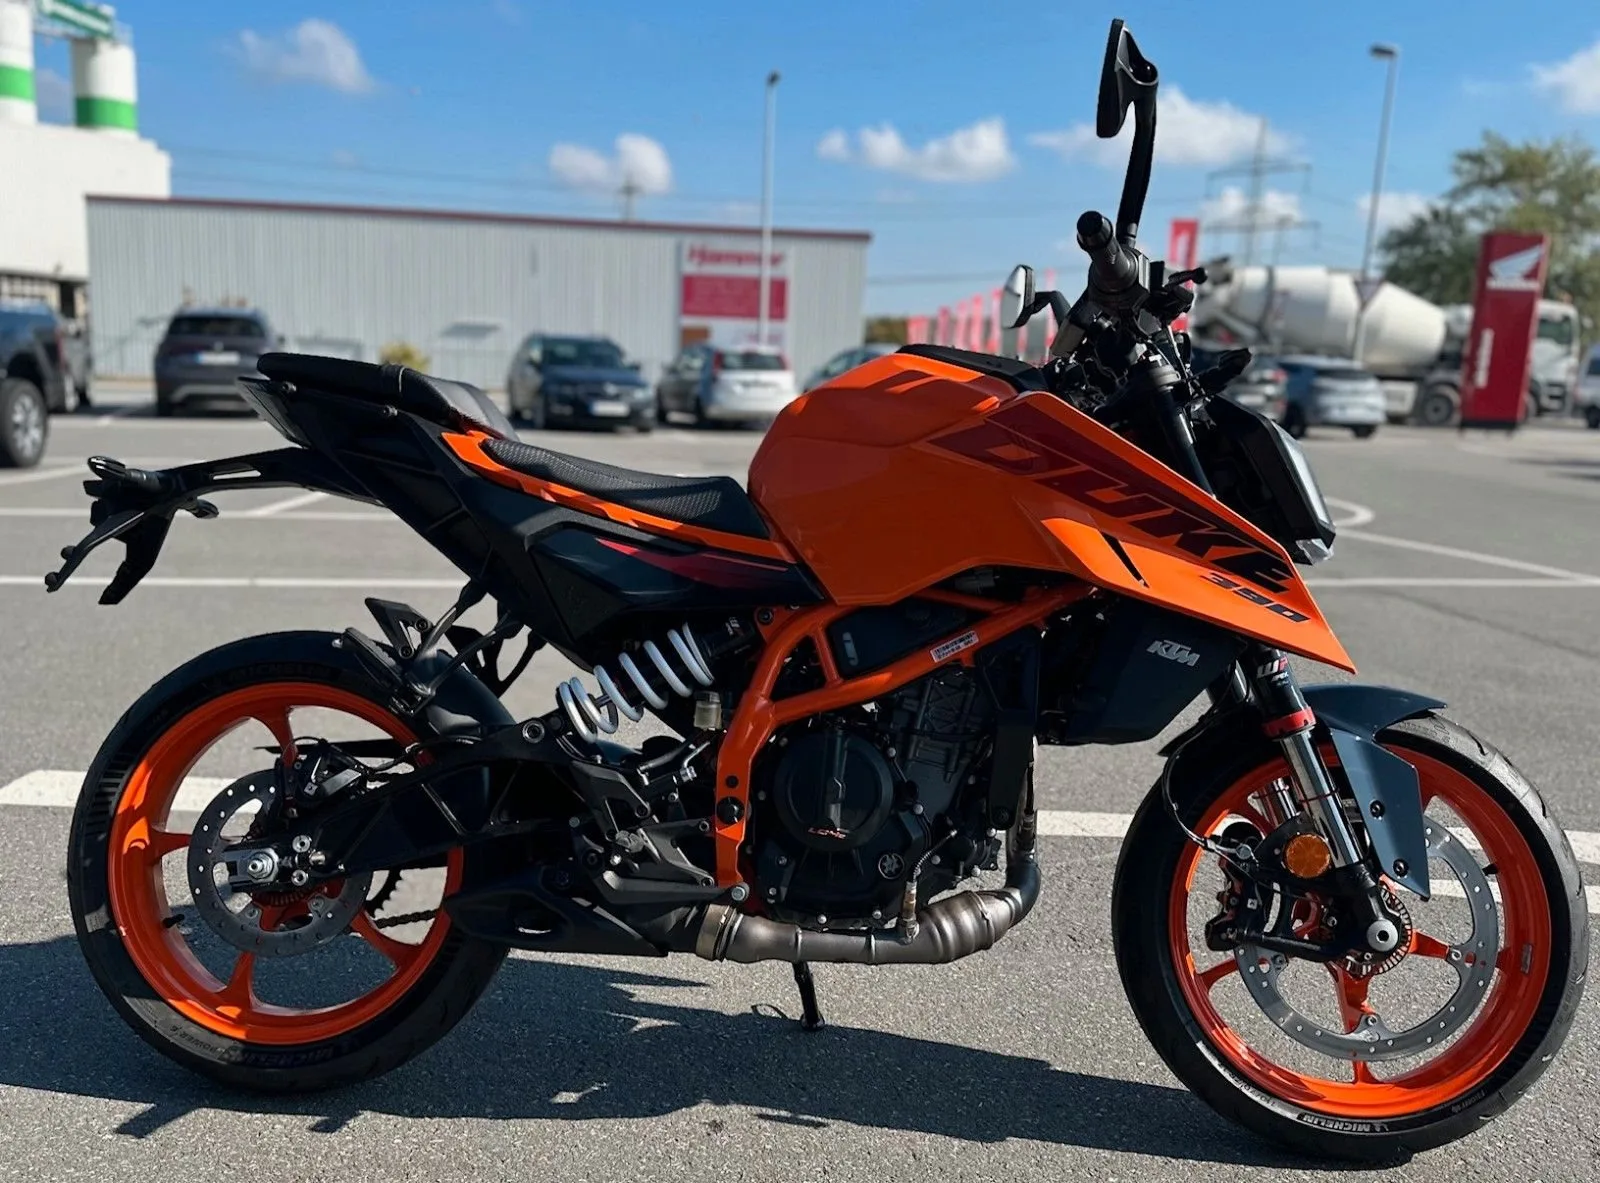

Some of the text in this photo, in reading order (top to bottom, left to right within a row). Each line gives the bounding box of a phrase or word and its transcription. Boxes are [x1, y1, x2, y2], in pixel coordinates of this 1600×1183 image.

[928, 418, 1294, 593] DUKE
[1199, 571, 1312, 623] 390
[1147, 639, 1200, 667] KTM
[1256, 655, 1289, 679] WP
[1301, 1113, 1372, 1132] MICHELIN
